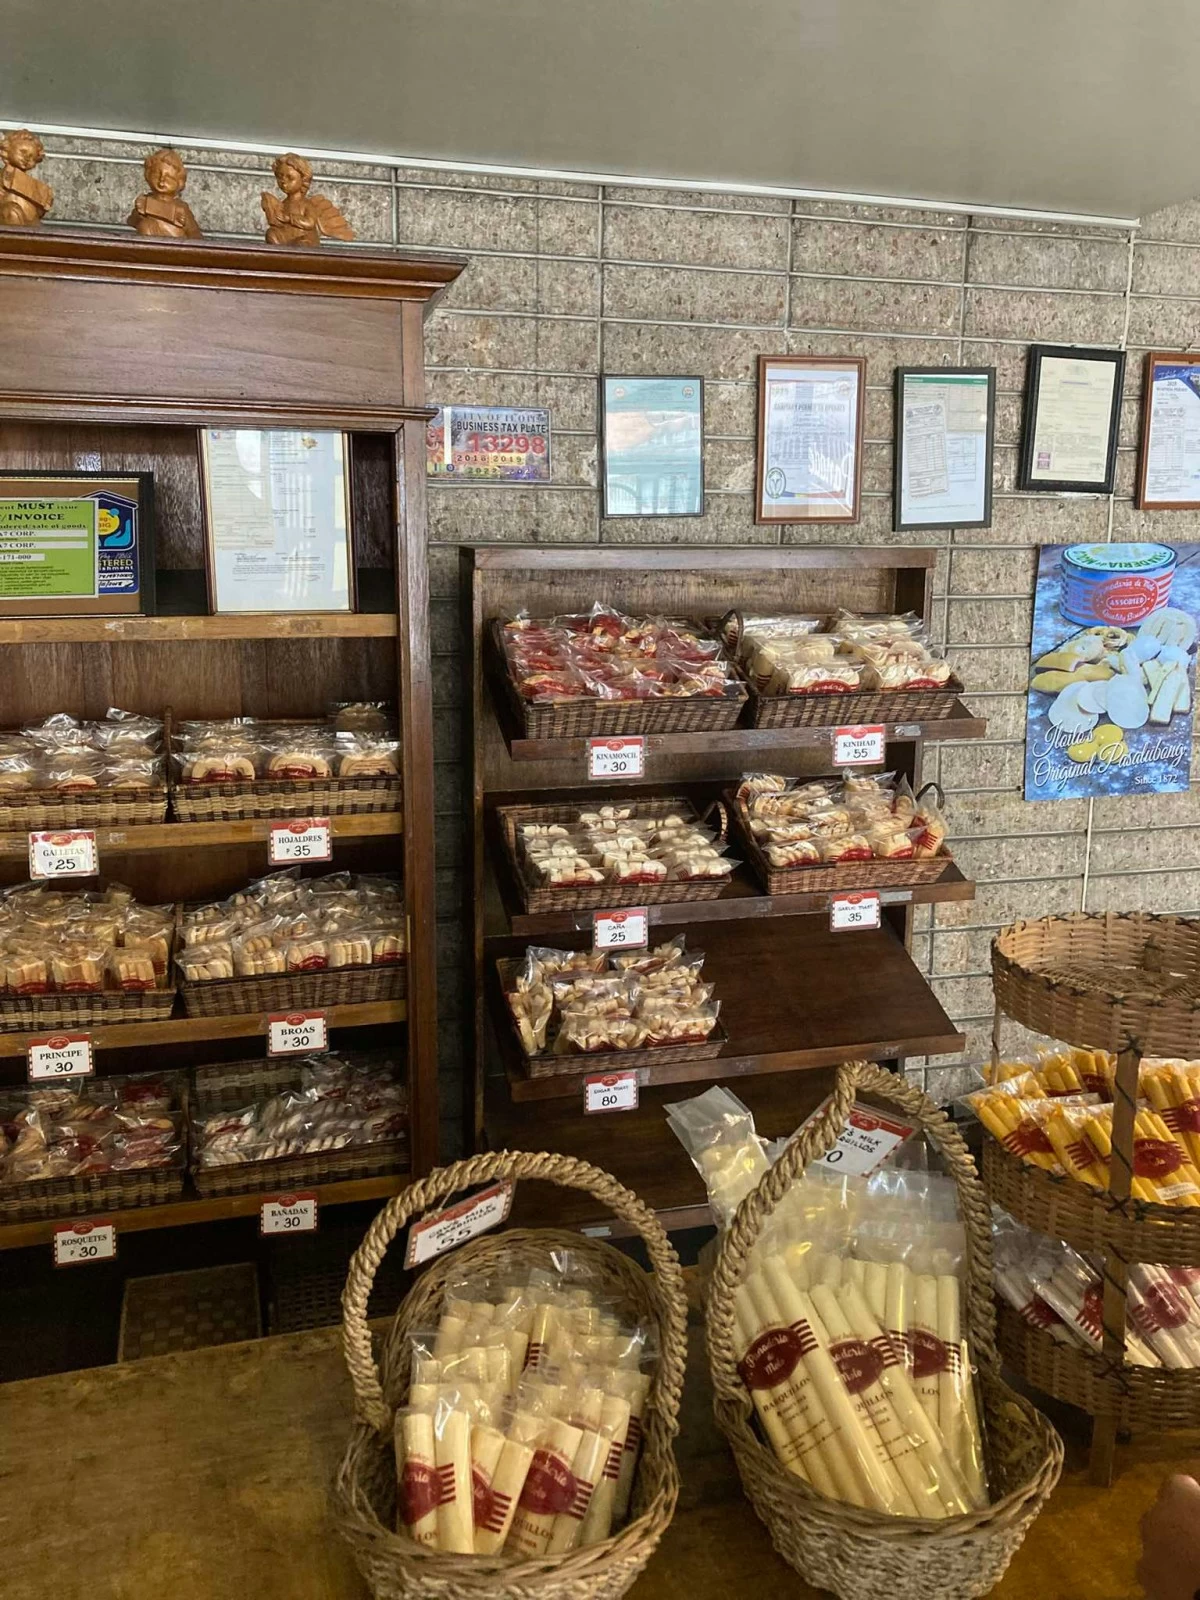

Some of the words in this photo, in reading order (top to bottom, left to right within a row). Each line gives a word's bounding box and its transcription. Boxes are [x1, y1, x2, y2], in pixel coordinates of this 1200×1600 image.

[457, 421, 499, 432] BUSINESS
[501, 423, 518, 432] TAX
[520, 424, 547, 434] PLATE
[468, 433, 546, 454] 13298
[1109, 597, 1144, 606] ASSORTED
[1032, 720, 1094, 758] Iloilo's
[853, 748, 868, 758] 55
[610, 762, 627, 772] 30
[1034, 752, 1098, 790] Original
[1097, 738, 1186, 774] Pasalubong
[1134, 776, 1157, 784] Since
[1158, 774, 1178, 784] 1872
[278, 835, 322, 844] HOJALDRES
[43, 847, 85, 856] GALLETAS
[293, 845, 311, 856] 35
[55, 859, 76, 870] 25
[848, 912, 862, 922] 35
[610, 932, 626, 943] 25
[281, 1026, 315, 1036] BROAS
[292, 1036, 309, 1047] 30
[40, 1050, 82, 1060] PRINCIPE
[54, 1062, 73, 1073] 30
[601, 1095, 617, 1106] 80
[839, 1136, 876, 1154] QUILLOS
[859, 1135, 882, 1147] MILK
[271, 1207, 308, 1217] BAÑADAS
[465, 1203, 494, 1219] MILK
[284, 1216, 300, 1228] 30
[61, 1234, 107, 1246] ROSQUETES
[436, 1226, 472, 1251] 55
[79, 1246, 97, 1258] 30
[745, 1333, 788, 1369] Panaderia
[763, 1376, 812, 1413] BARQUILLOS
